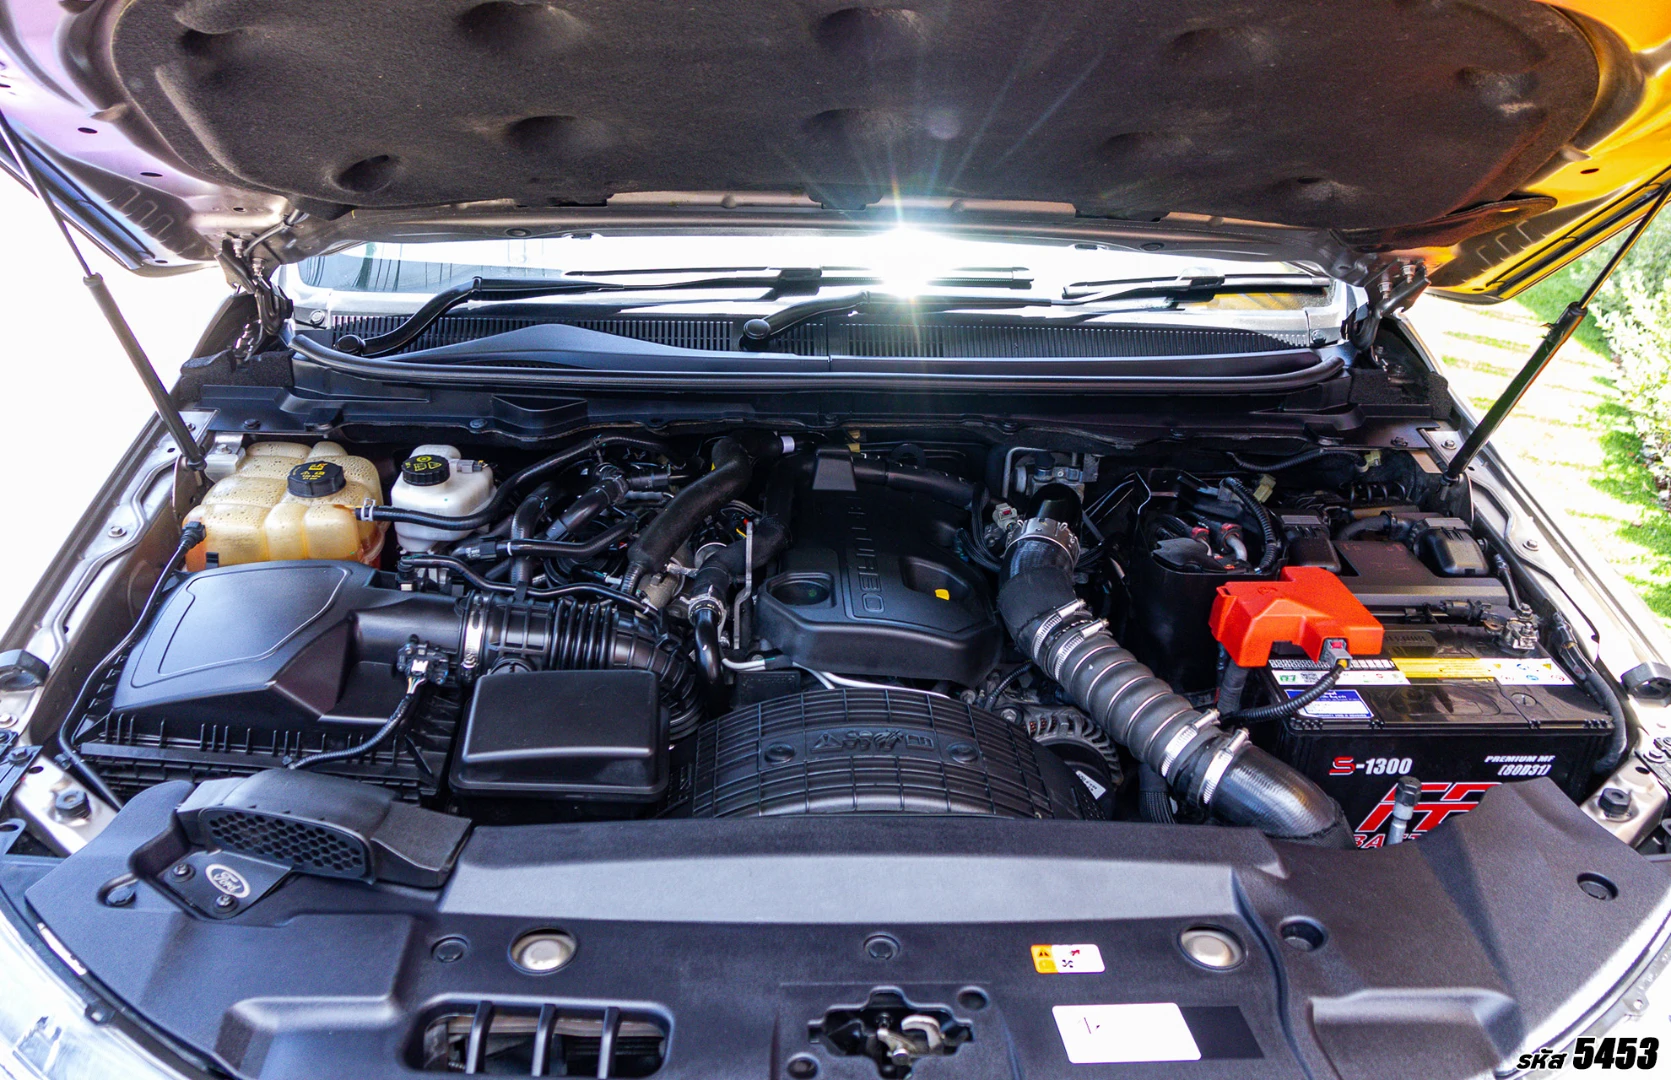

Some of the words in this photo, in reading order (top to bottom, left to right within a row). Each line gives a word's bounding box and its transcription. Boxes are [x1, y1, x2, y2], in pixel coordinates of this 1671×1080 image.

[1329, 756, 1412, 775] S-1300
[1484, 755, 1537, 763] PREMIUM
[213, 871, 242, 892] Ford
